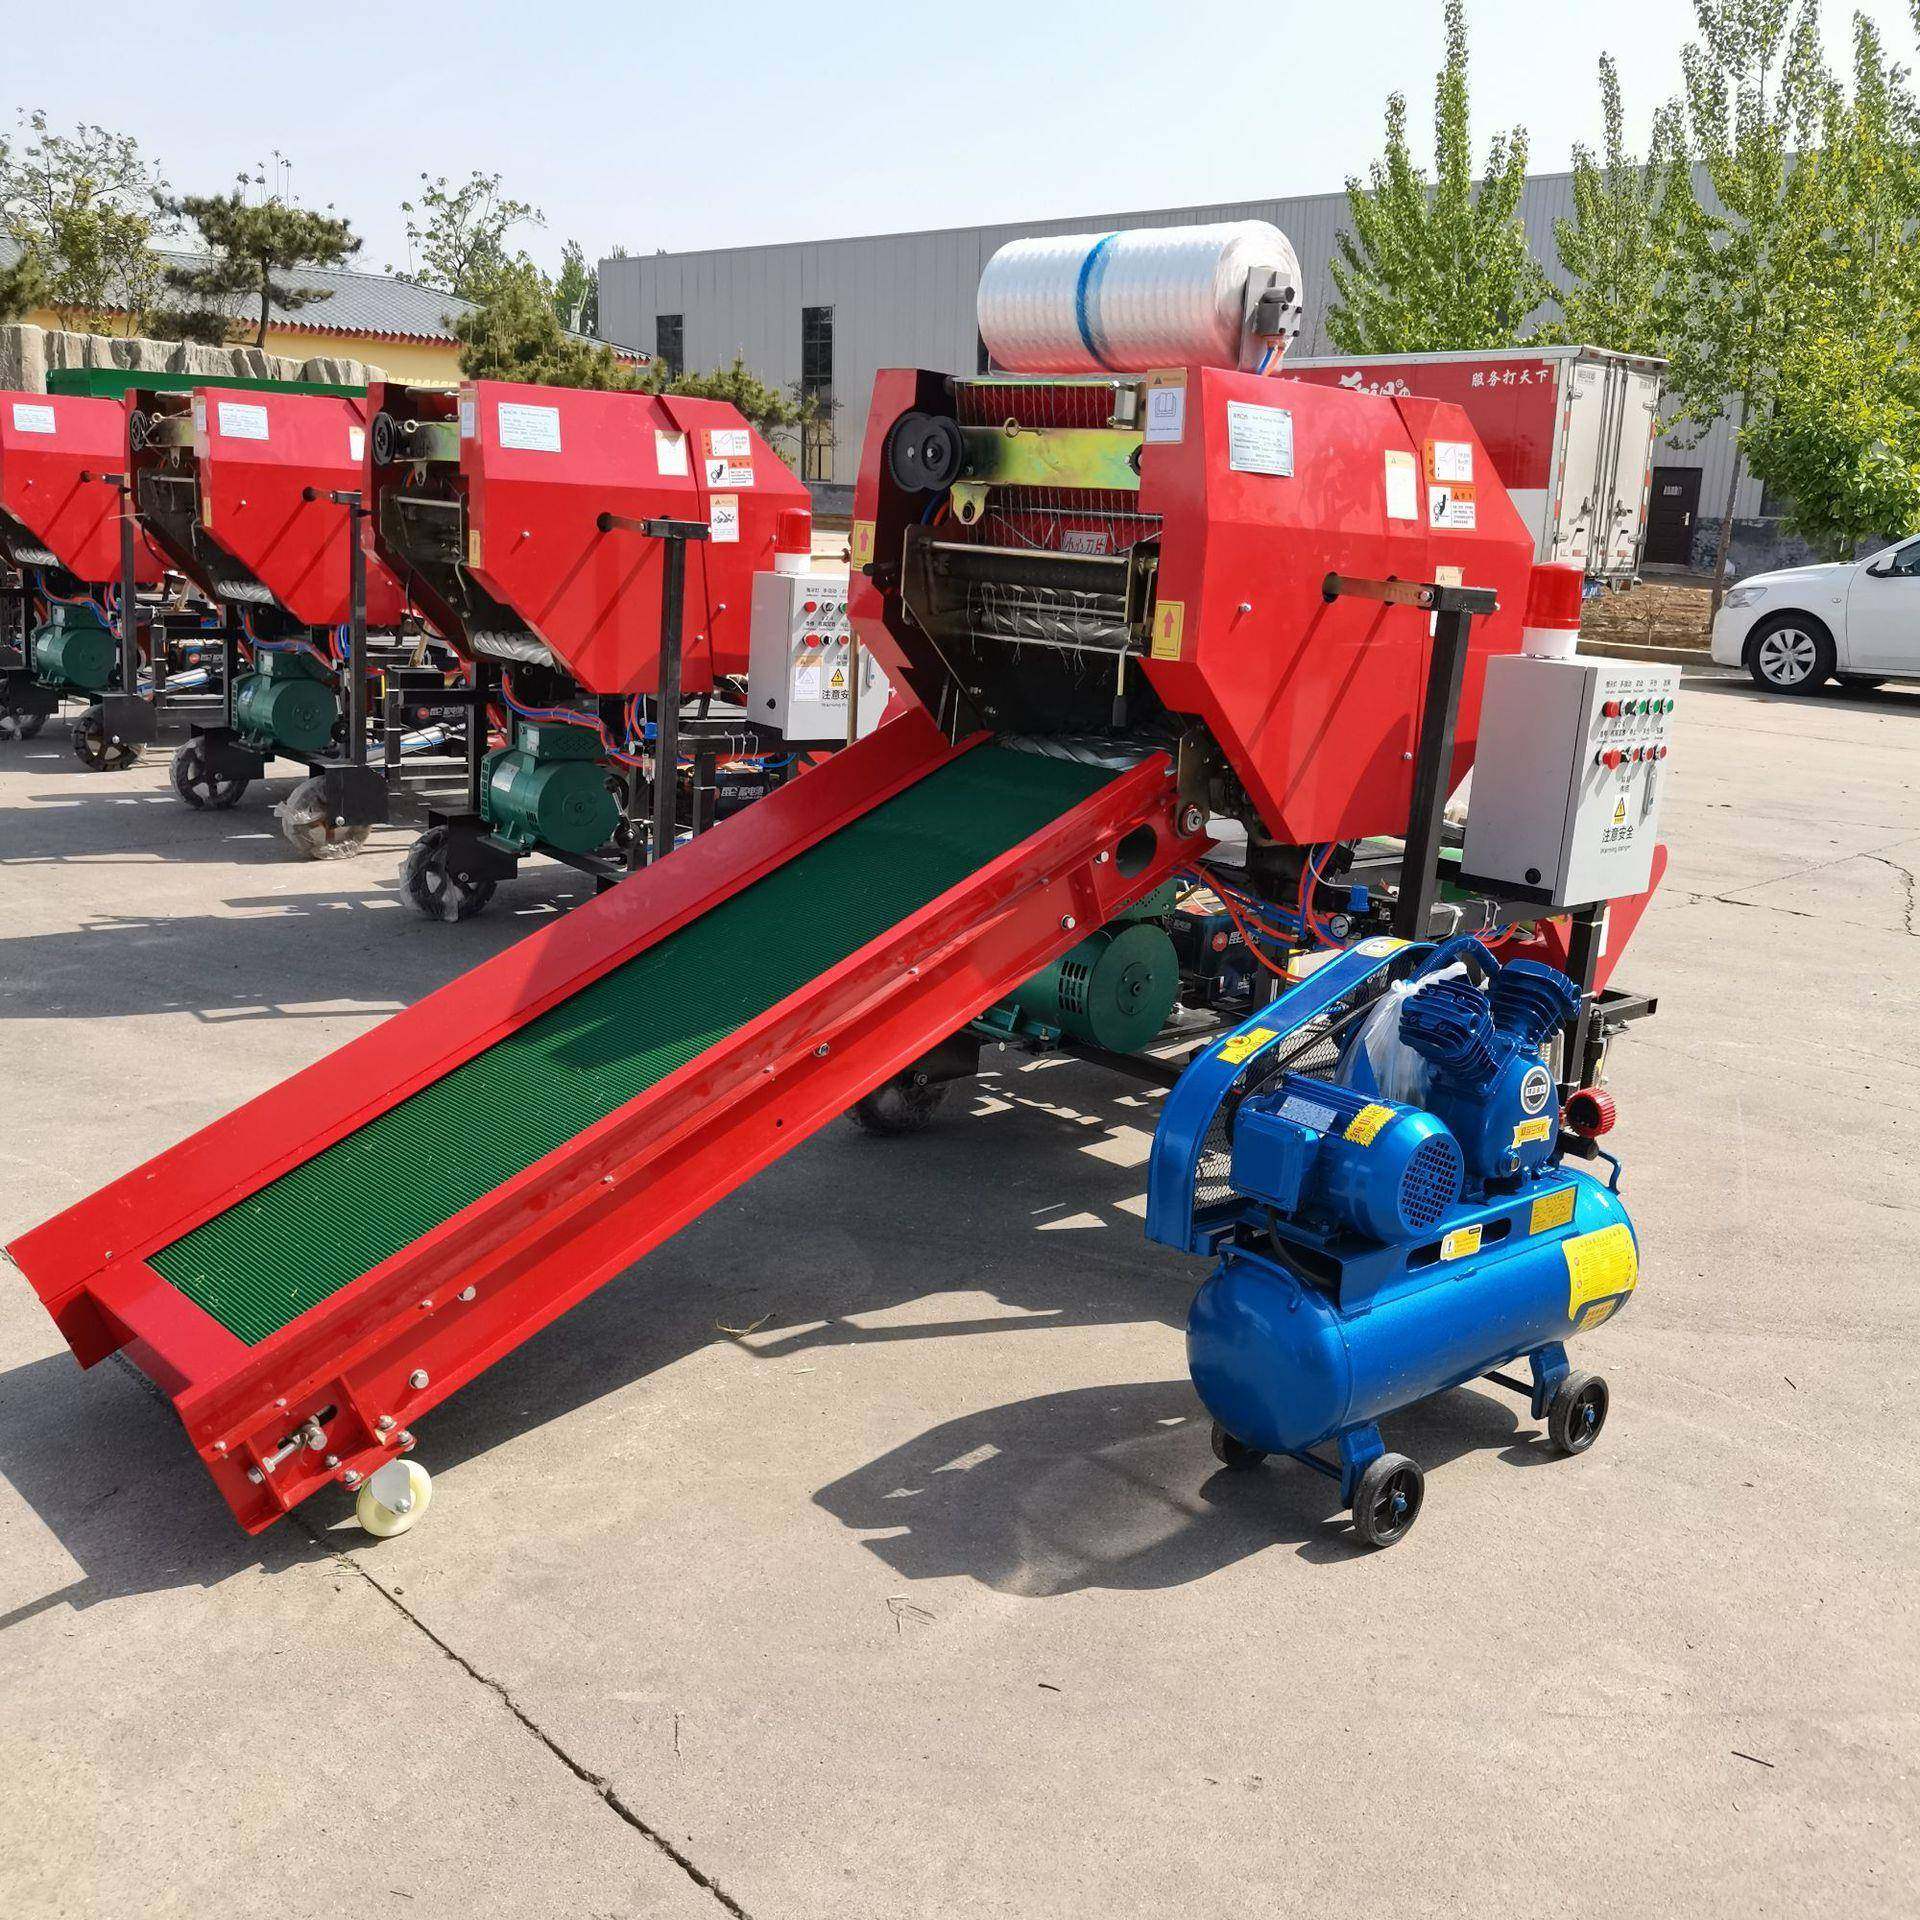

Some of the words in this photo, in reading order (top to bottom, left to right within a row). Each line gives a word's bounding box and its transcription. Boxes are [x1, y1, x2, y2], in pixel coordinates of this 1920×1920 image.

[1472, 369, 1549, 388] 服务打天下
[822, 689, 850, 700] 注意安
[1602, 825, 1634, 843] 注意安全
